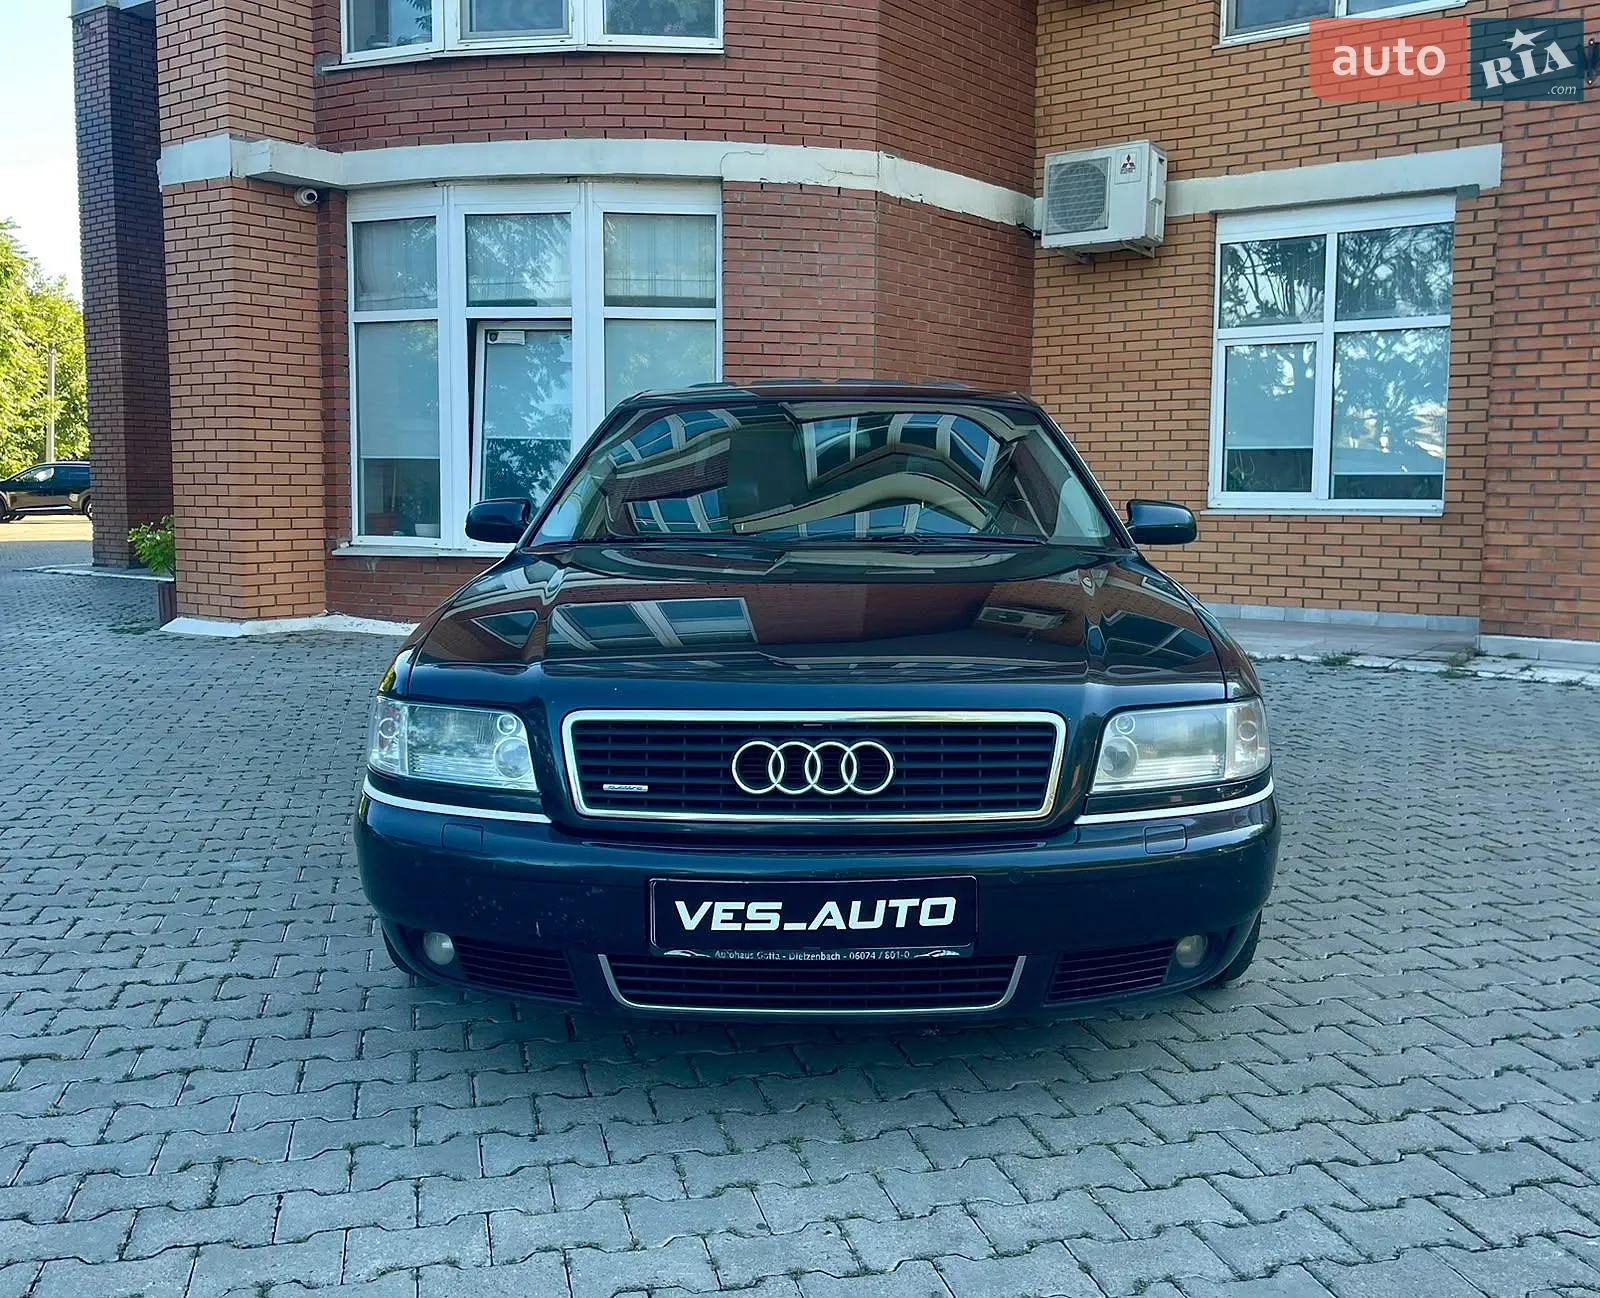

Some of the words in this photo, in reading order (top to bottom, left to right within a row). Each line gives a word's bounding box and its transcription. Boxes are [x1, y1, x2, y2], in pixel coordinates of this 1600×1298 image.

[674, 896, 957, 931] VES_AUTO
[714, 950, 754, 960] Autohaus
[788, 951, 841, 960] Dietzenbach
[849, 951, 876, 960] 06074
